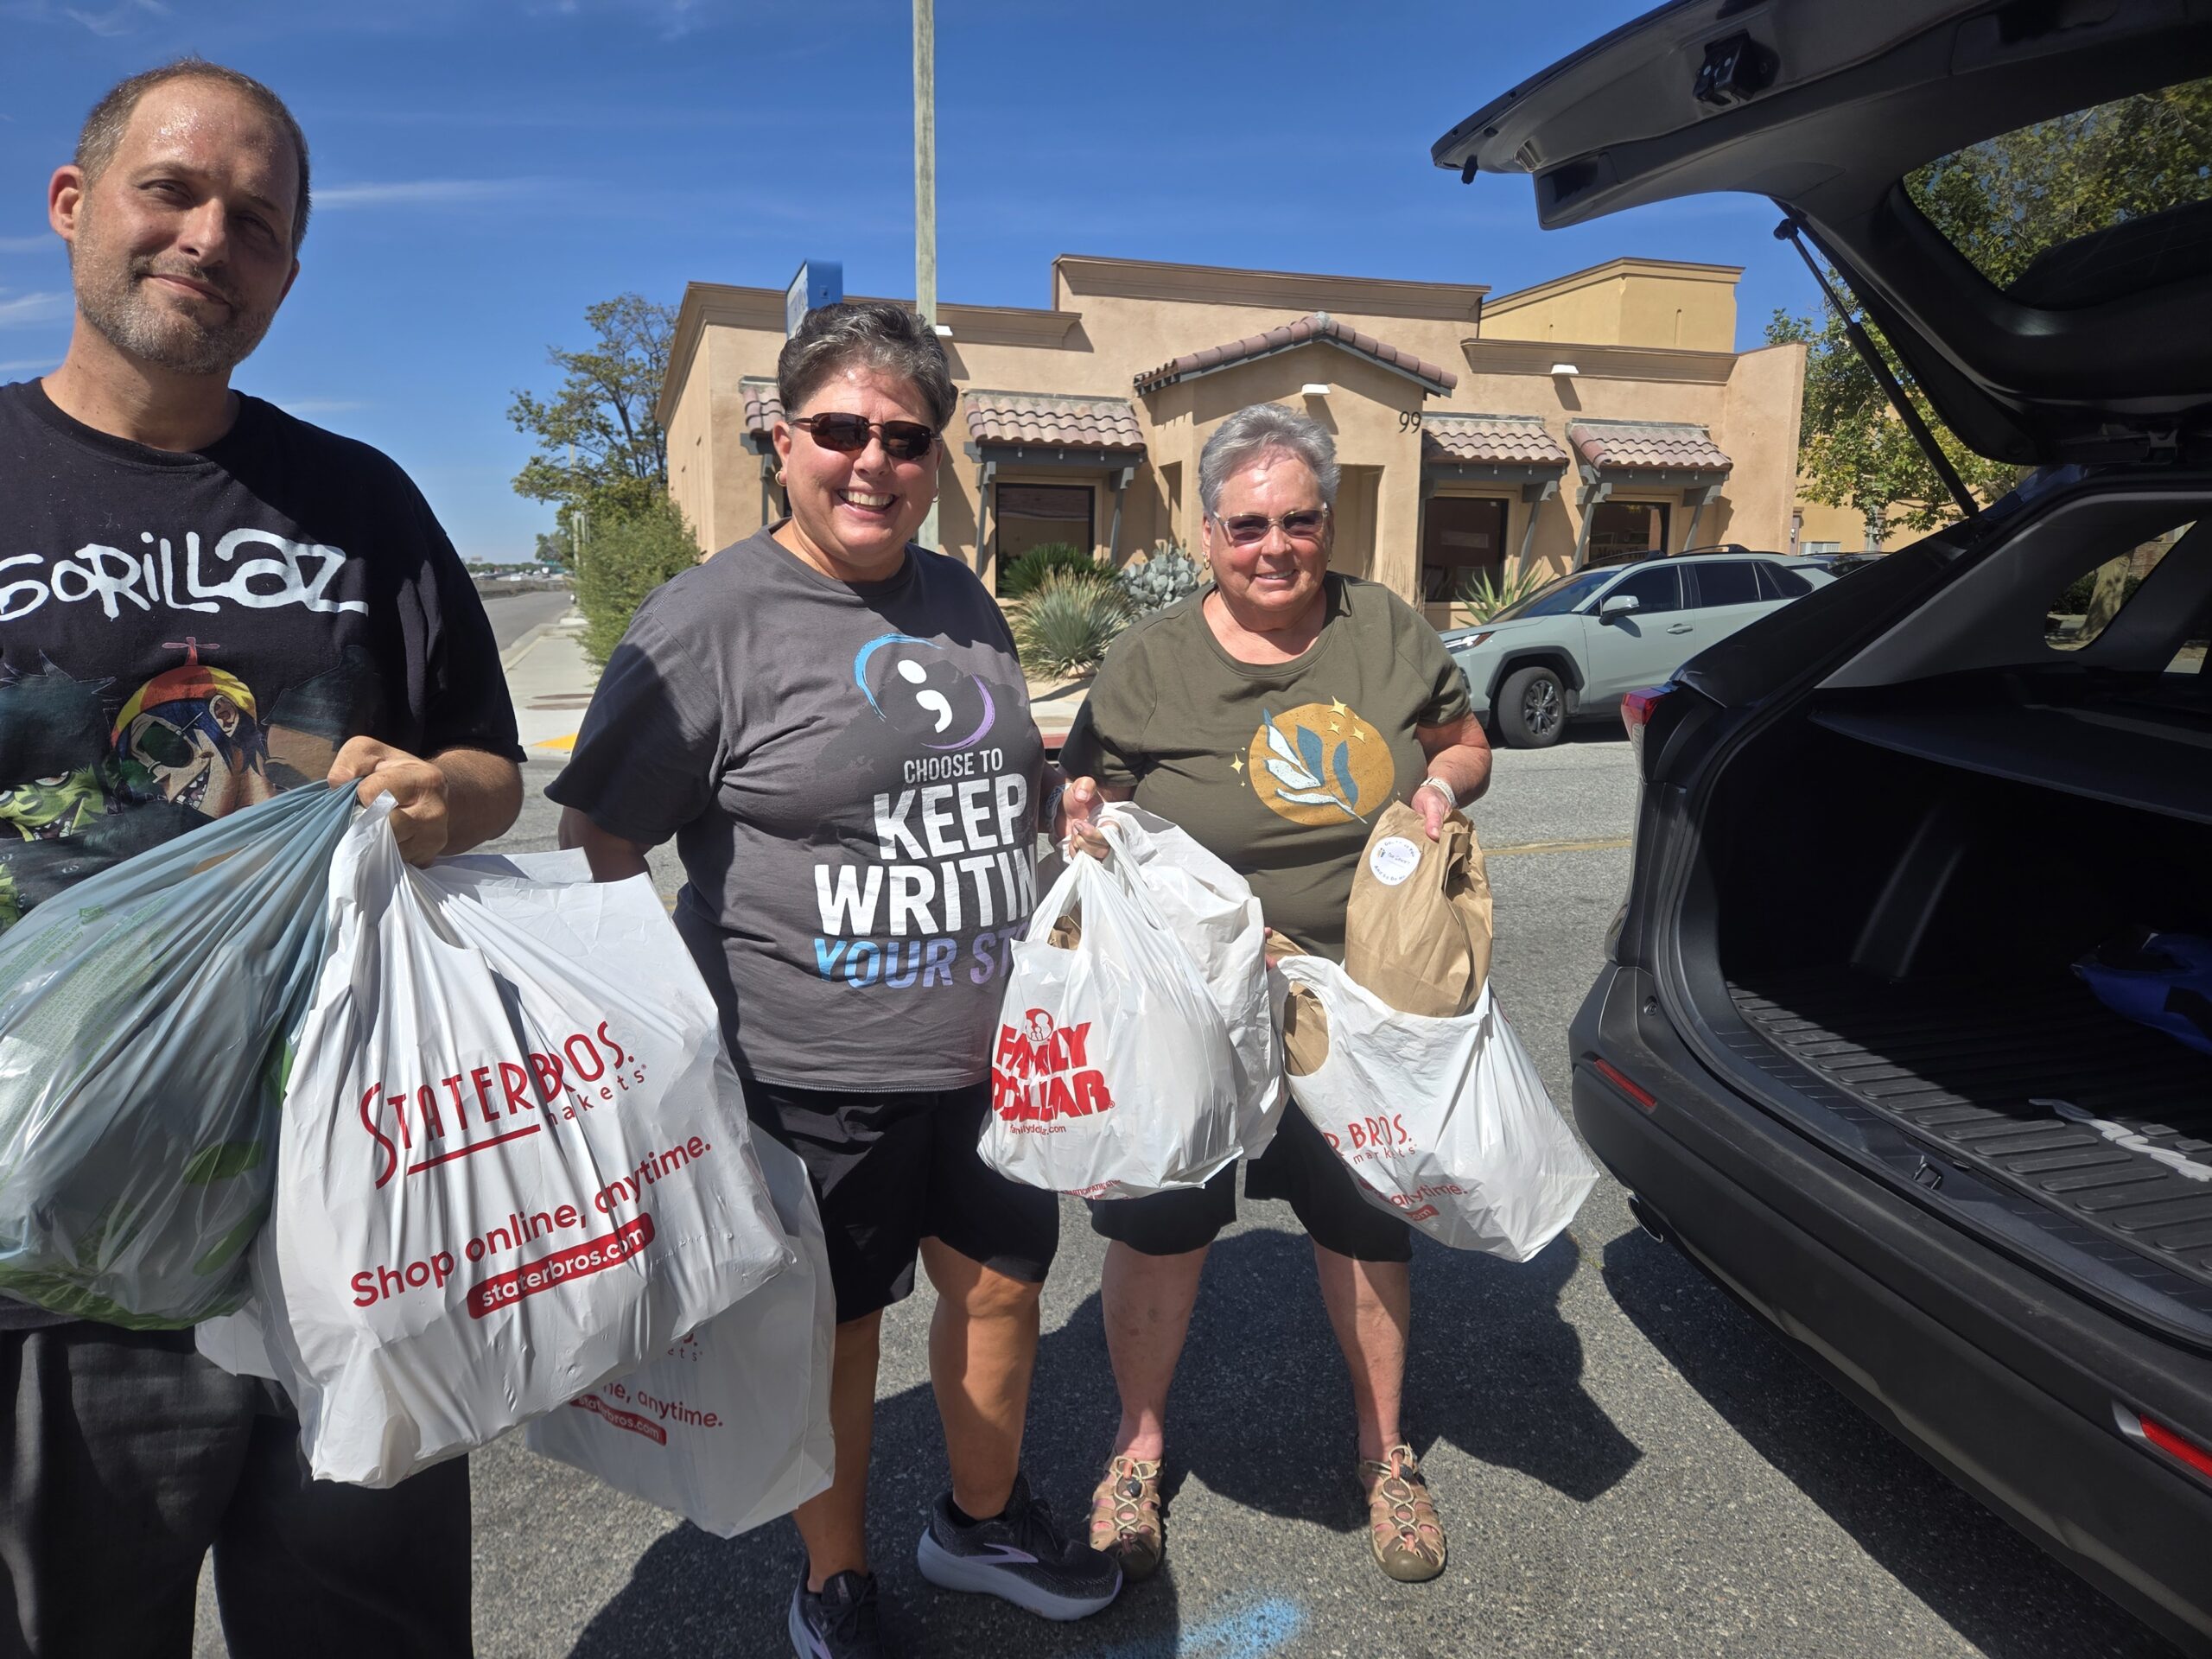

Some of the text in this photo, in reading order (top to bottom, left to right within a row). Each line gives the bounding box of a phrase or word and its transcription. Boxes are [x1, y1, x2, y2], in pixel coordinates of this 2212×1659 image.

[1398, 410, 1421, 435] 99
[903, 748, 1003, 784] CHOOSE TO
[873, 772, 1027, 861] KEEP
[814, 843, 1037, 937] WRITIN
[813, 938, 957, 989] YOUR
[359, 1062, 536, 1190] STATER
[1348, 1114, 1413, 1149] BROS.
[1390, 1183, 1468, 1206] anytime.
[350, 1135, 711, 1307] Shop online, anytime.
[481, 1227, 646, 1308] staterbros.com
[578, 1397, 661, 1440] statbros.com
[638, 1390, 723, 1427] anytime.
